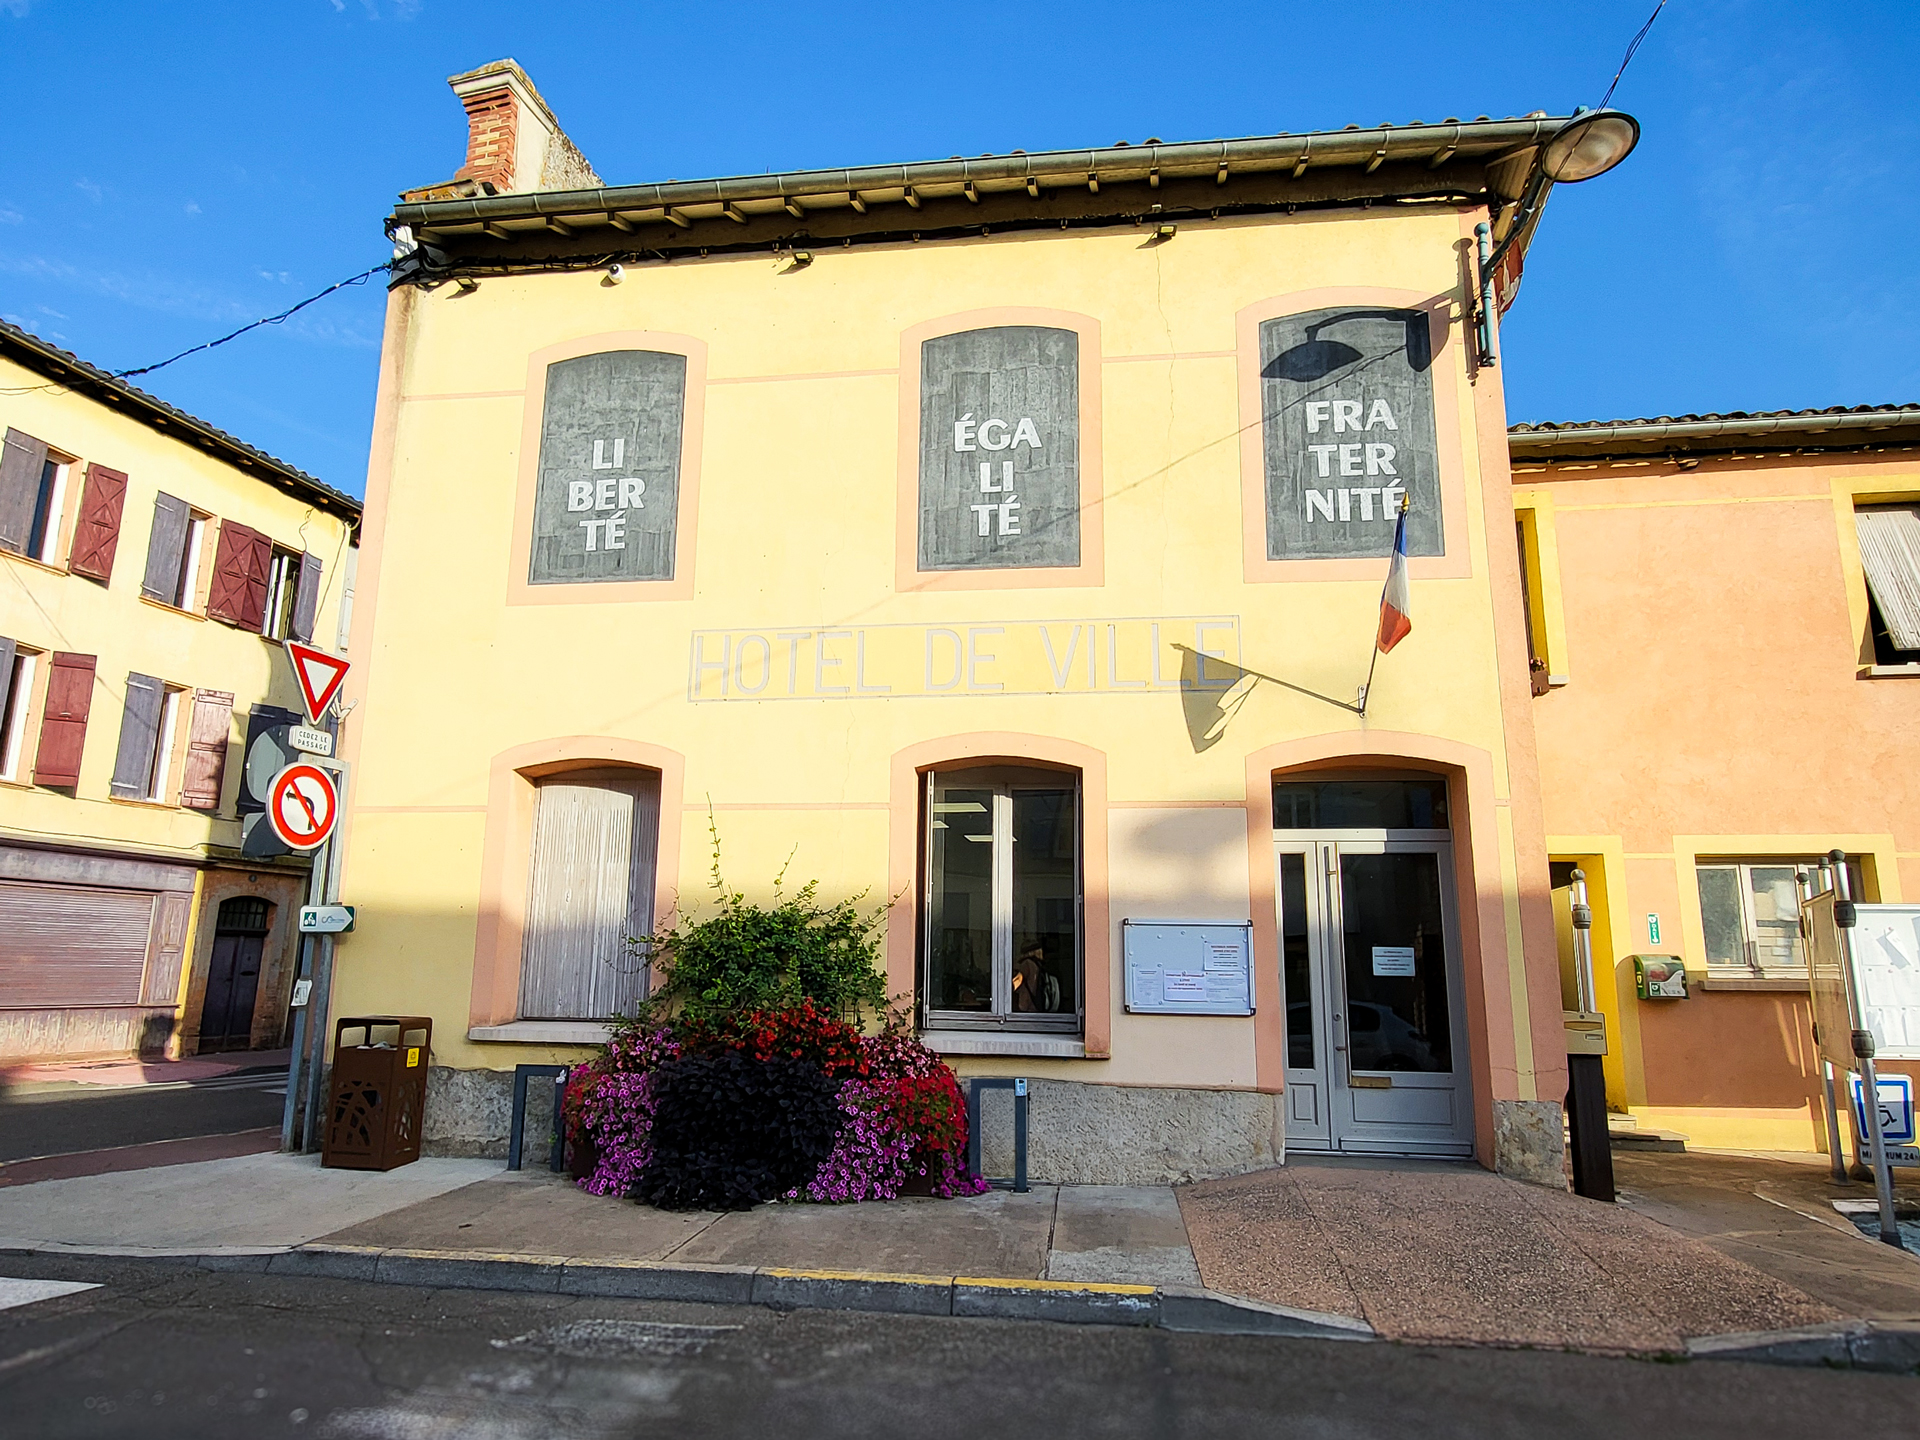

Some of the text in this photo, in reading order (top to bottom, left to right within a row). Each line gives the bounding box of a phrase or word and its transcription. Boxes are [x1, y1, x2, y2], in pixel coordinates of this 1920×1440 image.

[954, 412, 1042, 452] ÉGA
[1305, 399, 1399, 434] FRA
[592, 438, 624, 470] LI
[1307, 443, 1398, 478] TER
[567, 477, 646, 512] BER
[979, 461, 1014, 493] LI
[970, 494, 1021, 537] TÉ
[1304, 478, 1407, 522] NITÉ
[578, 510, 627, 552] TÉ
[694, 621, 1236, 697] HOTEL DE VILLE
[297, 738, 327, 751] PASSAGE
[299, 730, 328, 744] CEDEZ LE
